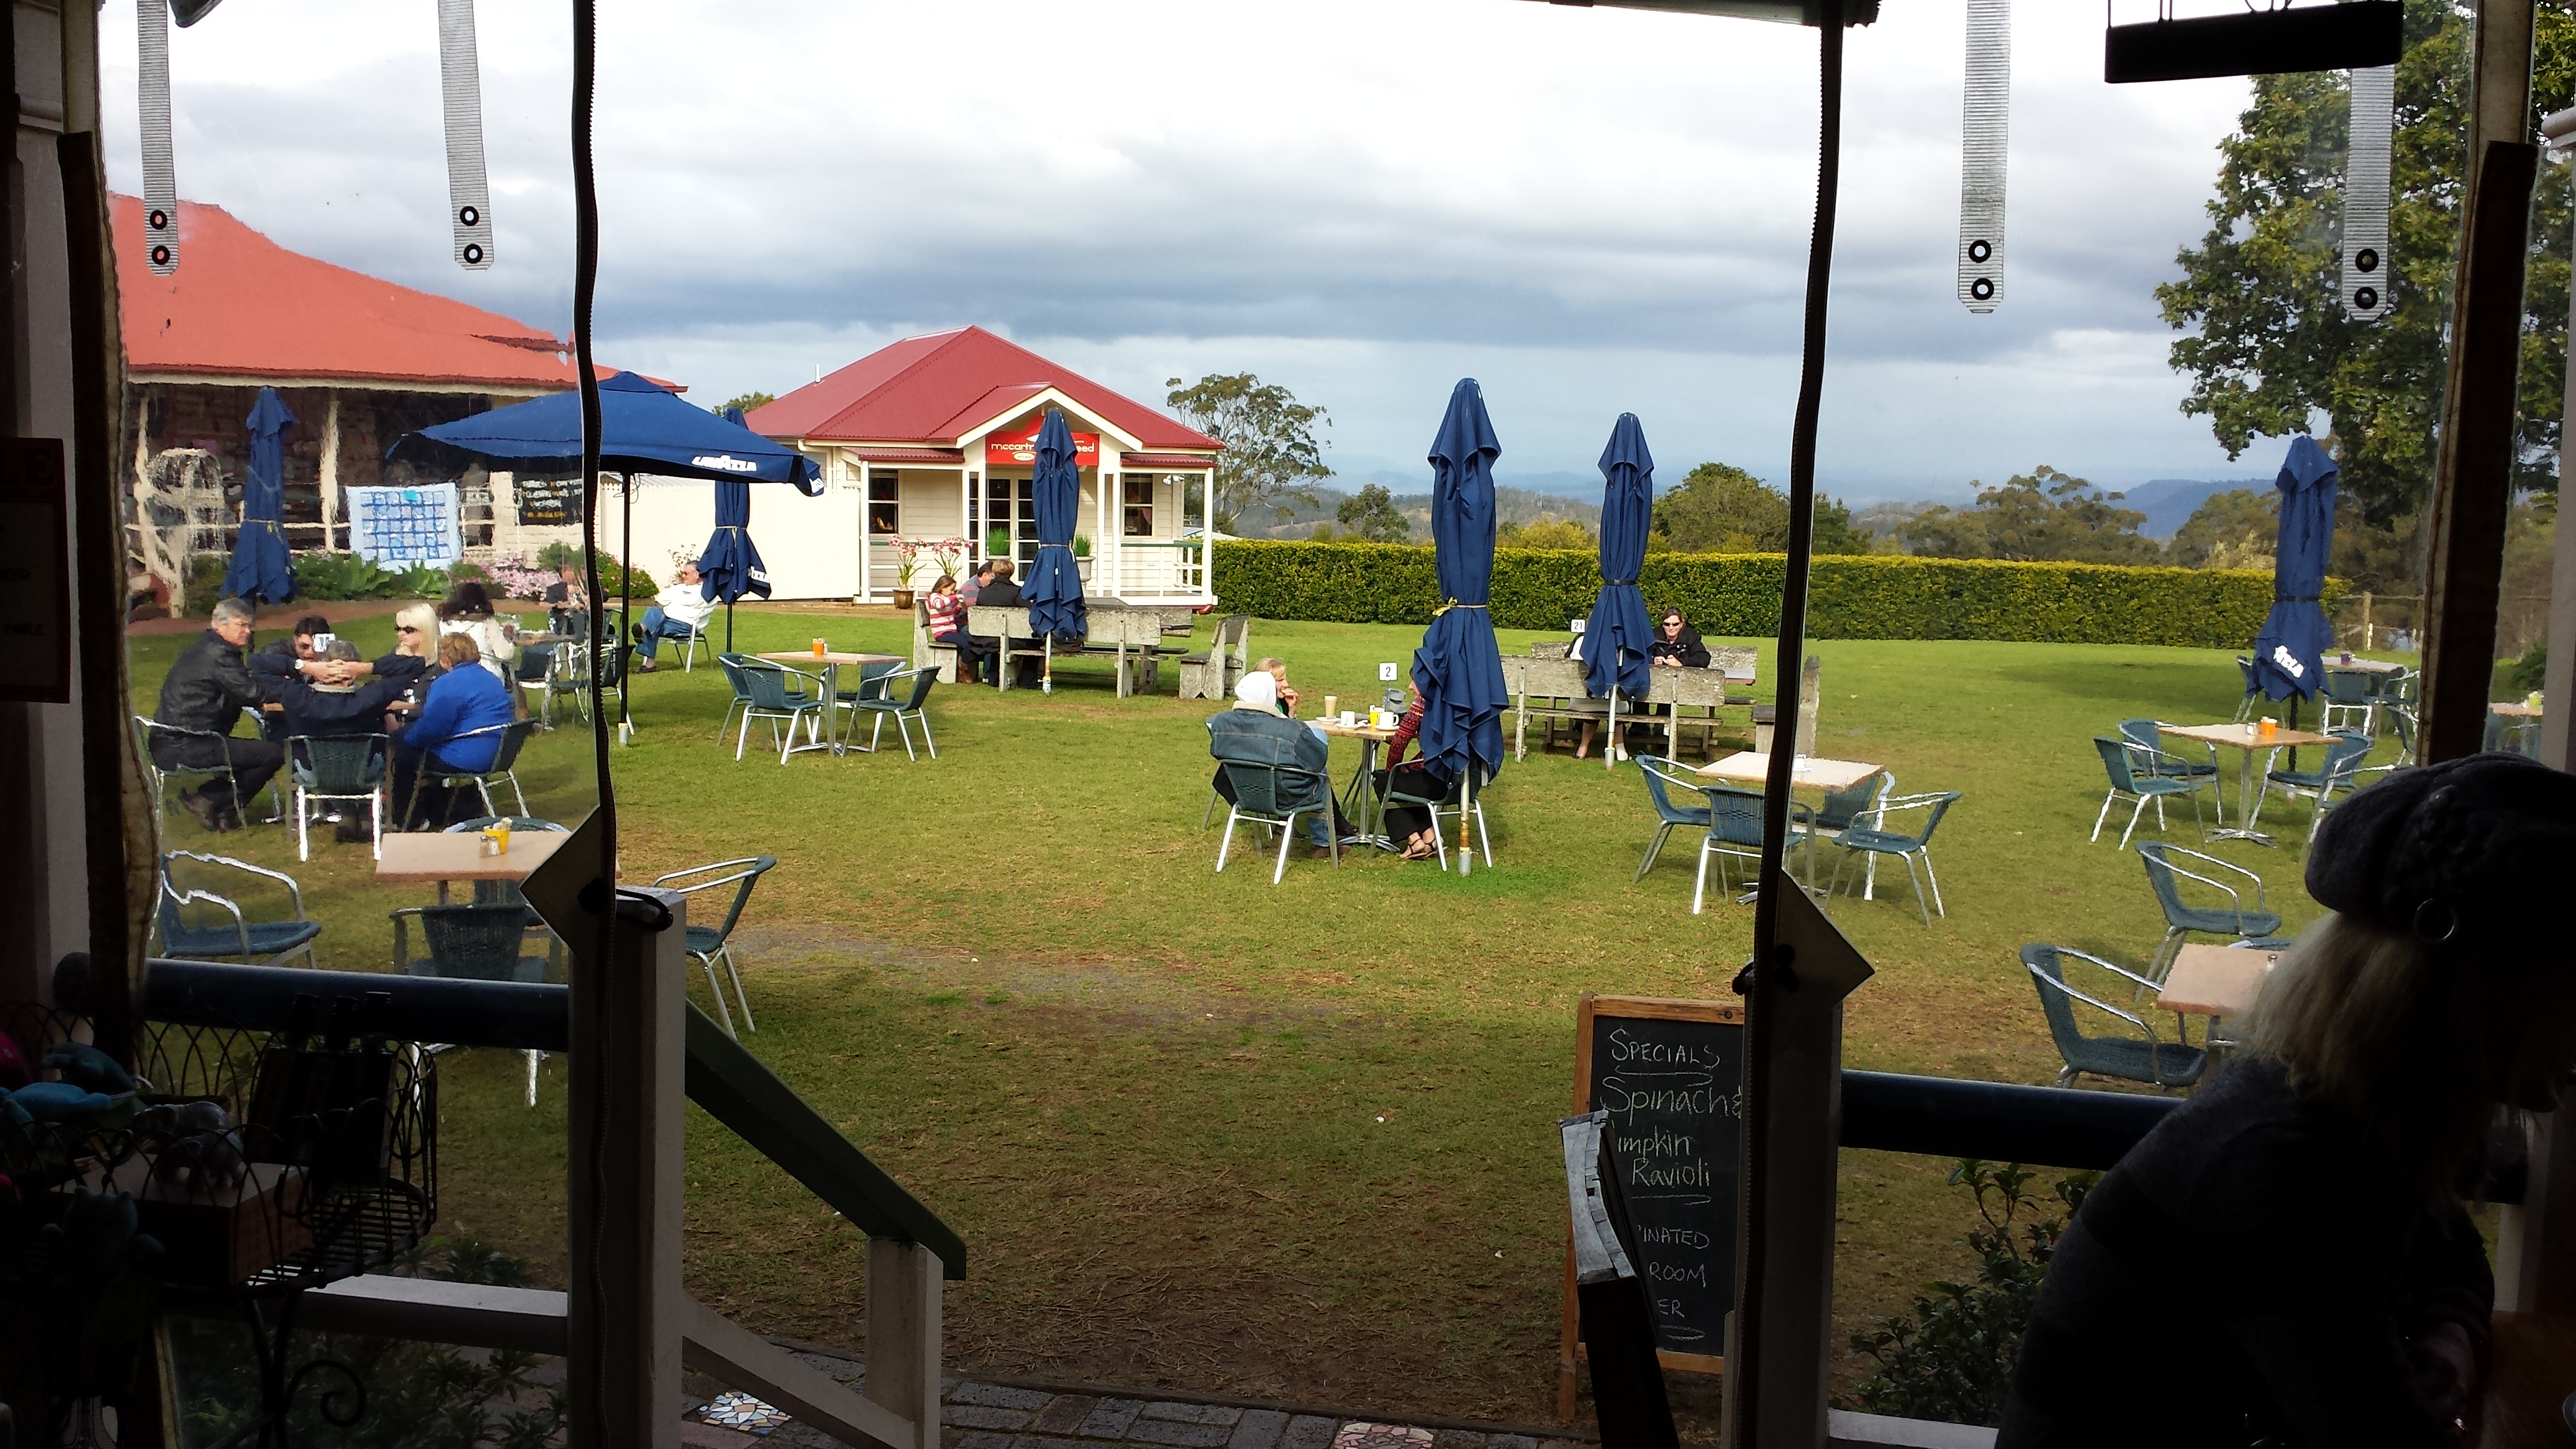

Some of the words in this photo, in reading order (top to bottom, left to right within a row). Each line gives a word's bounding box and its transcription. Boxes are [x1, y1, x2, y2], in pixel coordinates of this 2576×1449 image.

[1076, 442, 1095, 452] eed
[1574, 622, 1583, 630] 21
[1385, 666, 1391, 678] 2
[1609, 1028, 1720, 1069] SPECIALS
[1632, 1157, 1710, 1189] Ravioli
[1637, 1225, 1710, 1249] INATED
[1649, 1262, 1706, 1288] ROOM
[1657, 1299, 1685, 1318] ER
